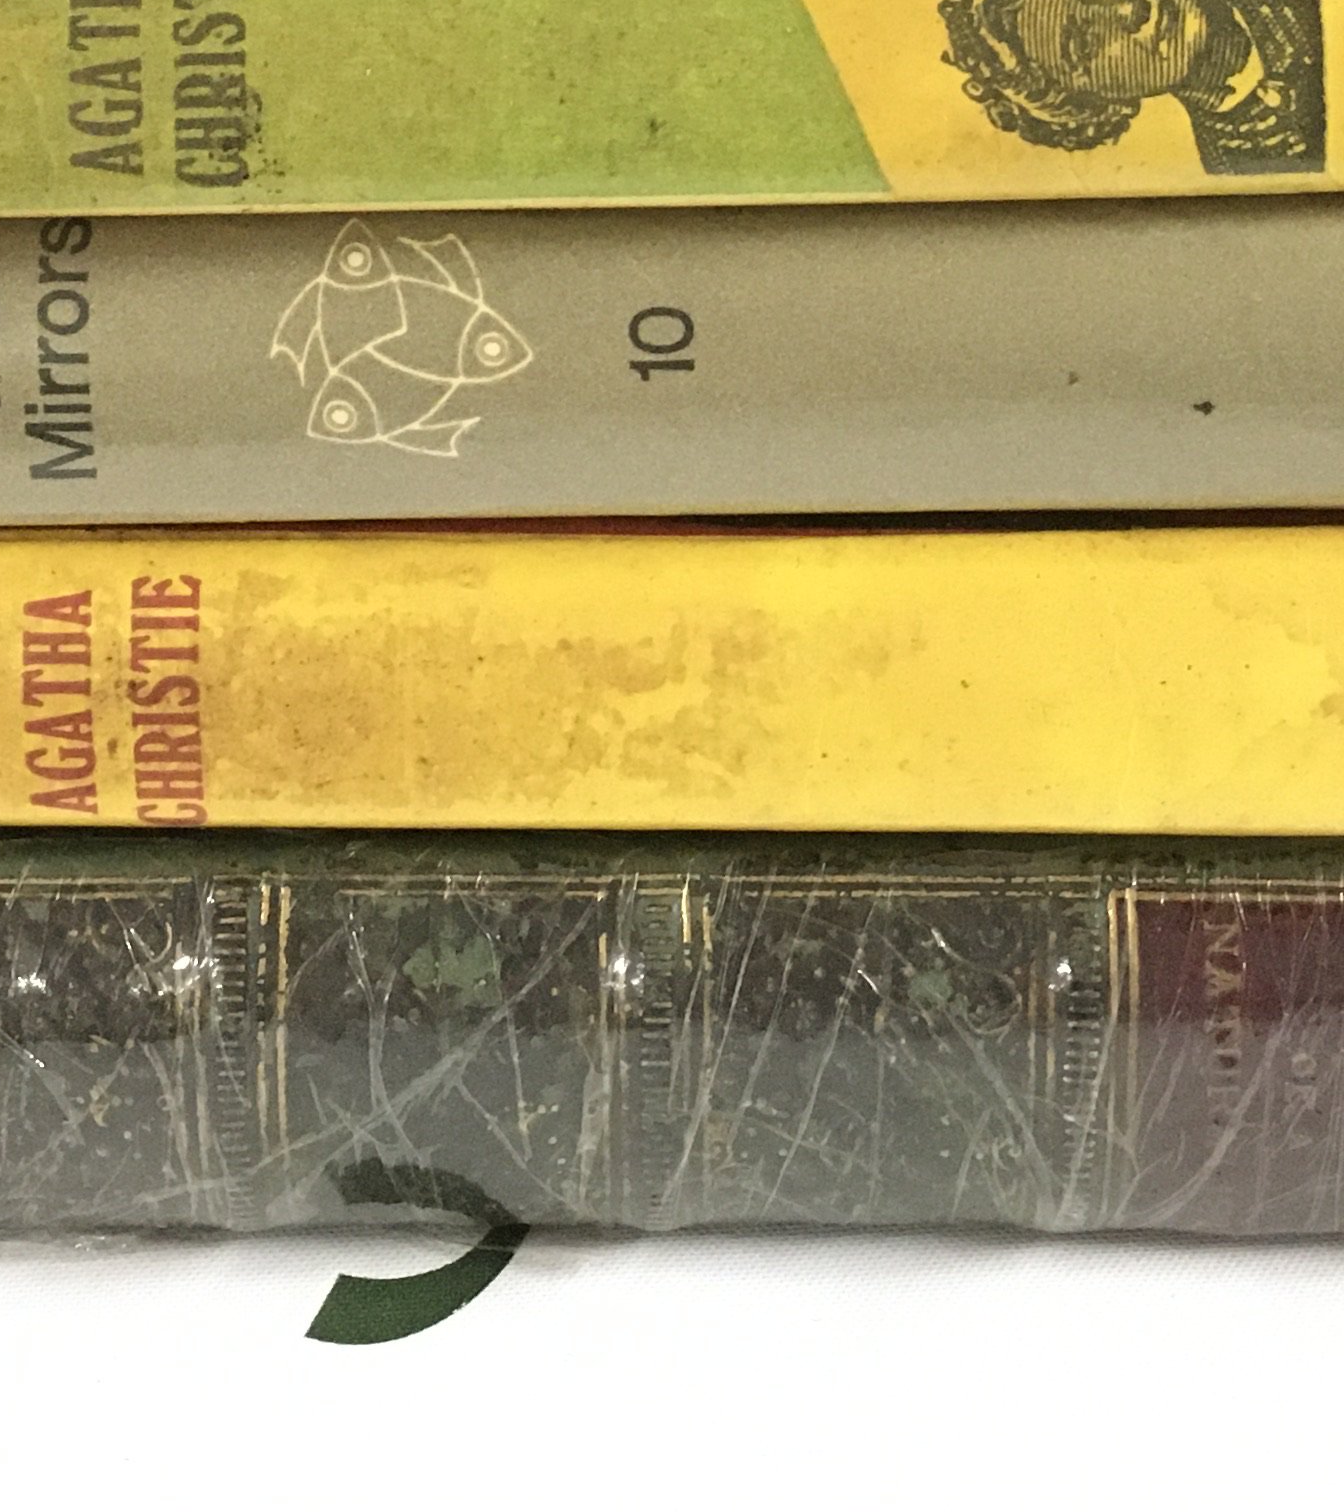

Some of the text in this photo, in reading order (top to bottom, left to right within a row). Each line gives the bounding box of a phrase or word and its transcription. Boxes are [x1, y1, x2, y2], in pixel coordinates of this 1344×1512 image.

[24, 216, 98, 480] Mirrors
[628, 306, 695, 381] 10
[22, 590, 98, 814] AGATHA
[127, 574, 208, 826] CHRISTIE
